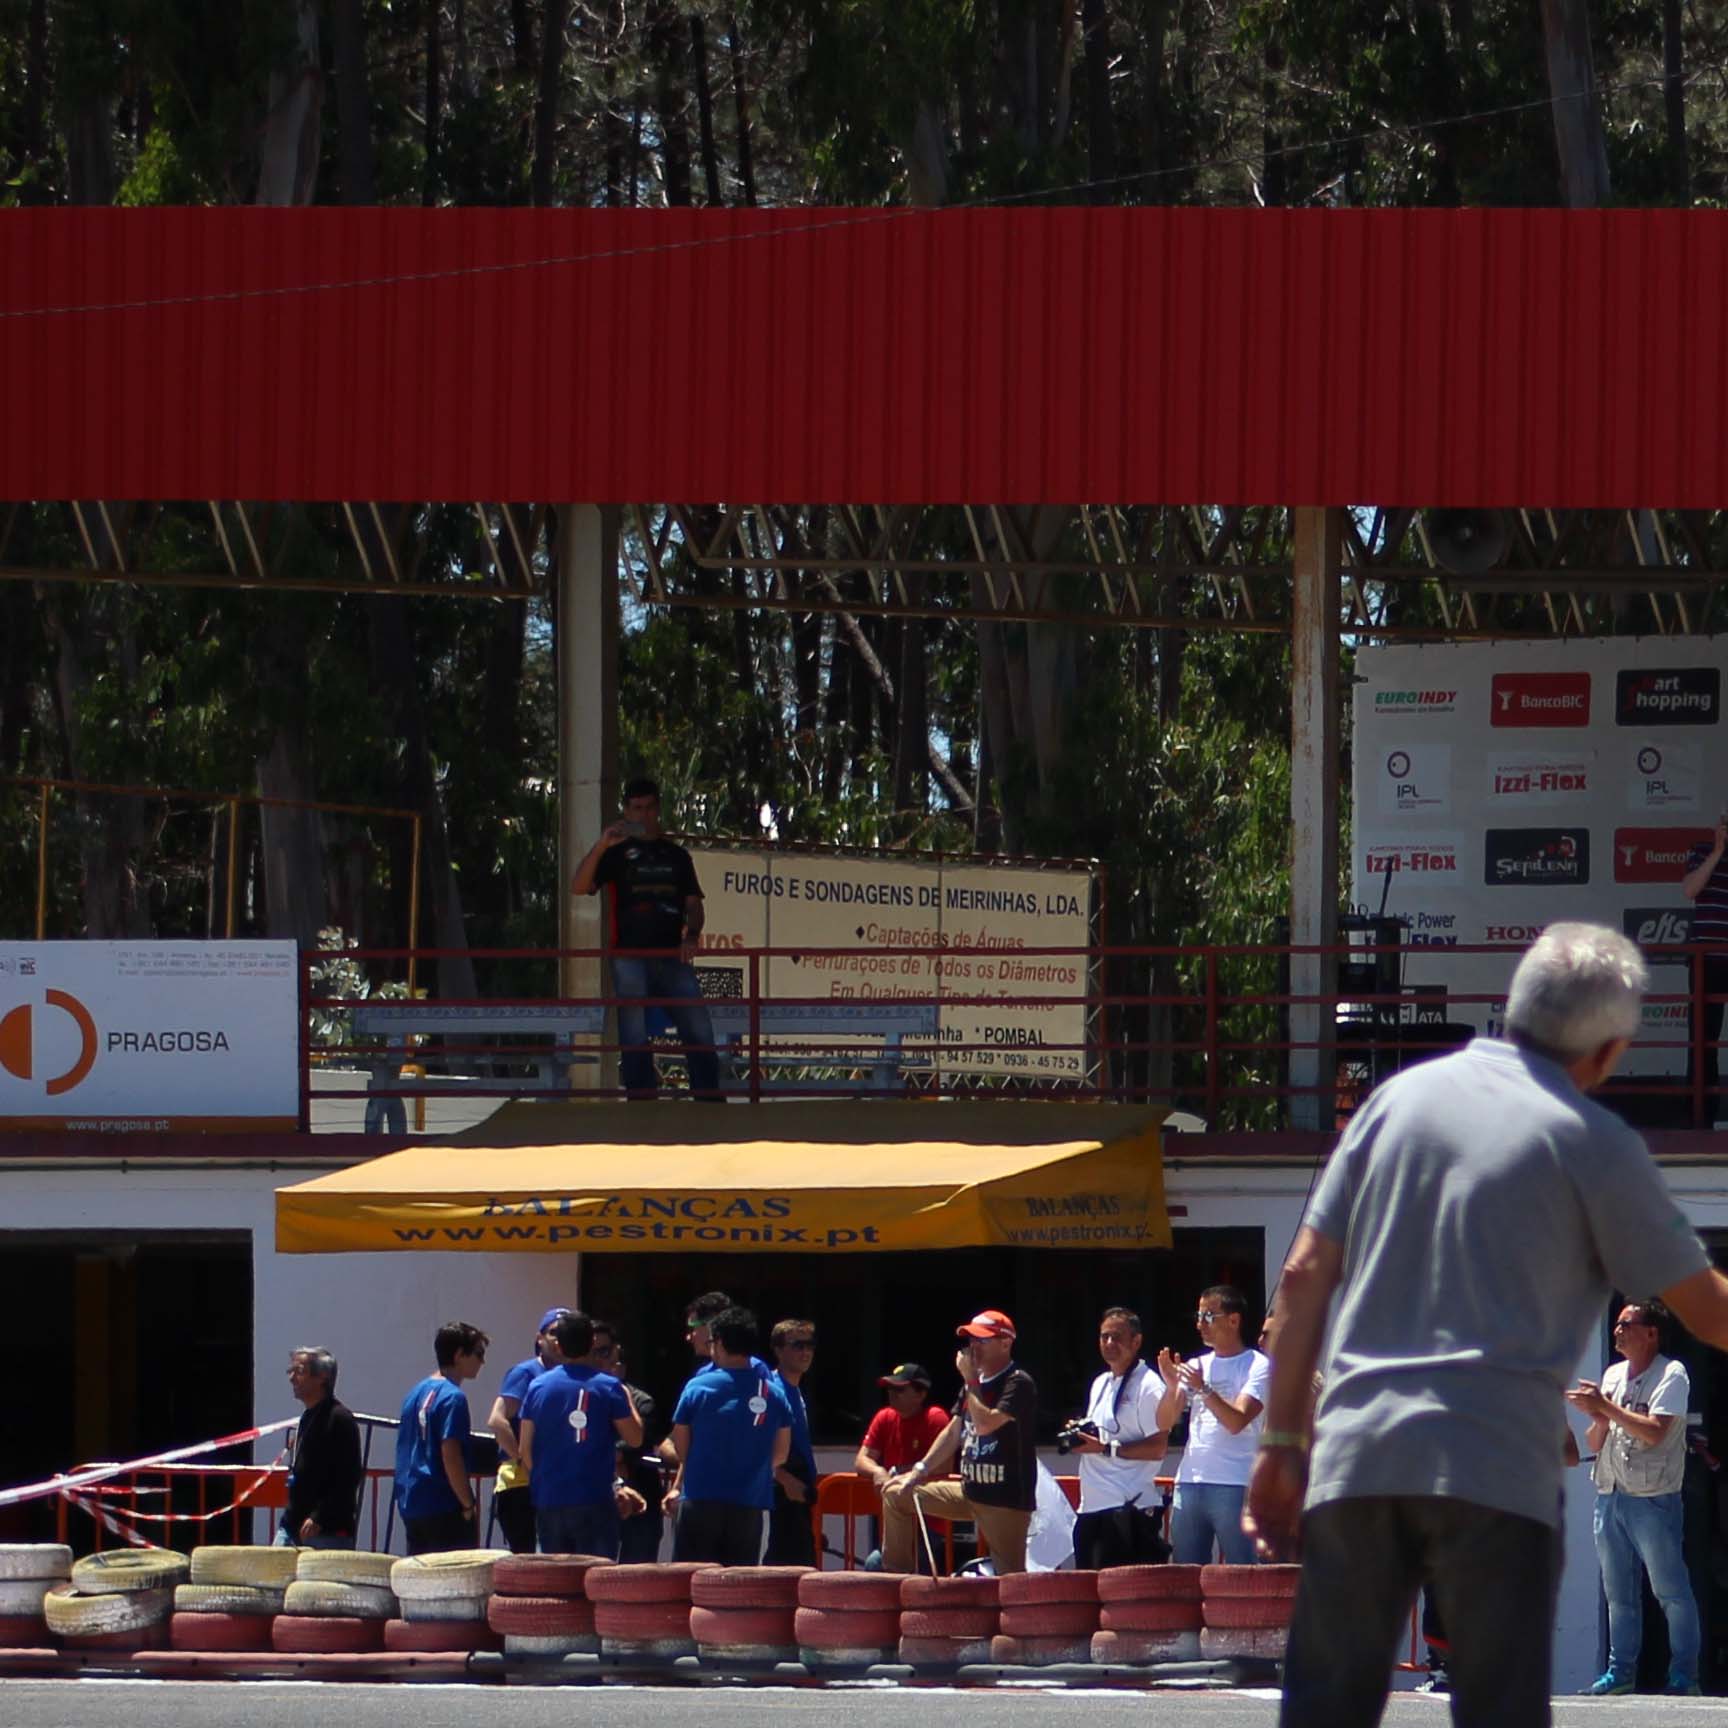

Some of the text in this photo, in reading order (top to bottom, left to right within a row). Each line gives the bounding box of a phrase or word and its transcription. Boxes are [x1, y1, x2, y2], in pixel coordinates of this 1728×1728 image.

[1375, 691, 1456, 705] EUROINDY
[1520, 695, 1585, 710] BancoBIC
[1397, 784, 1420, 799] IPL
[1494, 772, 1588, 793] Izzi-Flex
[1645, 780, 1670, 795] IPL
[723, 871, 1085, 918] FUROS E SONDAGENS DE MEIRINHAS, LDA.
[1417, 911, 1457, 930] Power
[866, 922, 949, 949] Captações
[953, 927, 971, 945] de
[900, 955, 921, 975] de
[926, 955, 971, 978] Todos
[976, 963, 994, 978] os
[998, 959, 1077, 984] Diâmetros
[107, 1031, 230, 1053] PRAGOSA
[984, 1026, 1047, 1046] POMBAL
[65, 1119, 171, 1134] www.pragosa.pt
[1025, 1195, 1121, 1220] BALANÇAS
[393, 1222, 881, 1248] www.pestronix.pt
